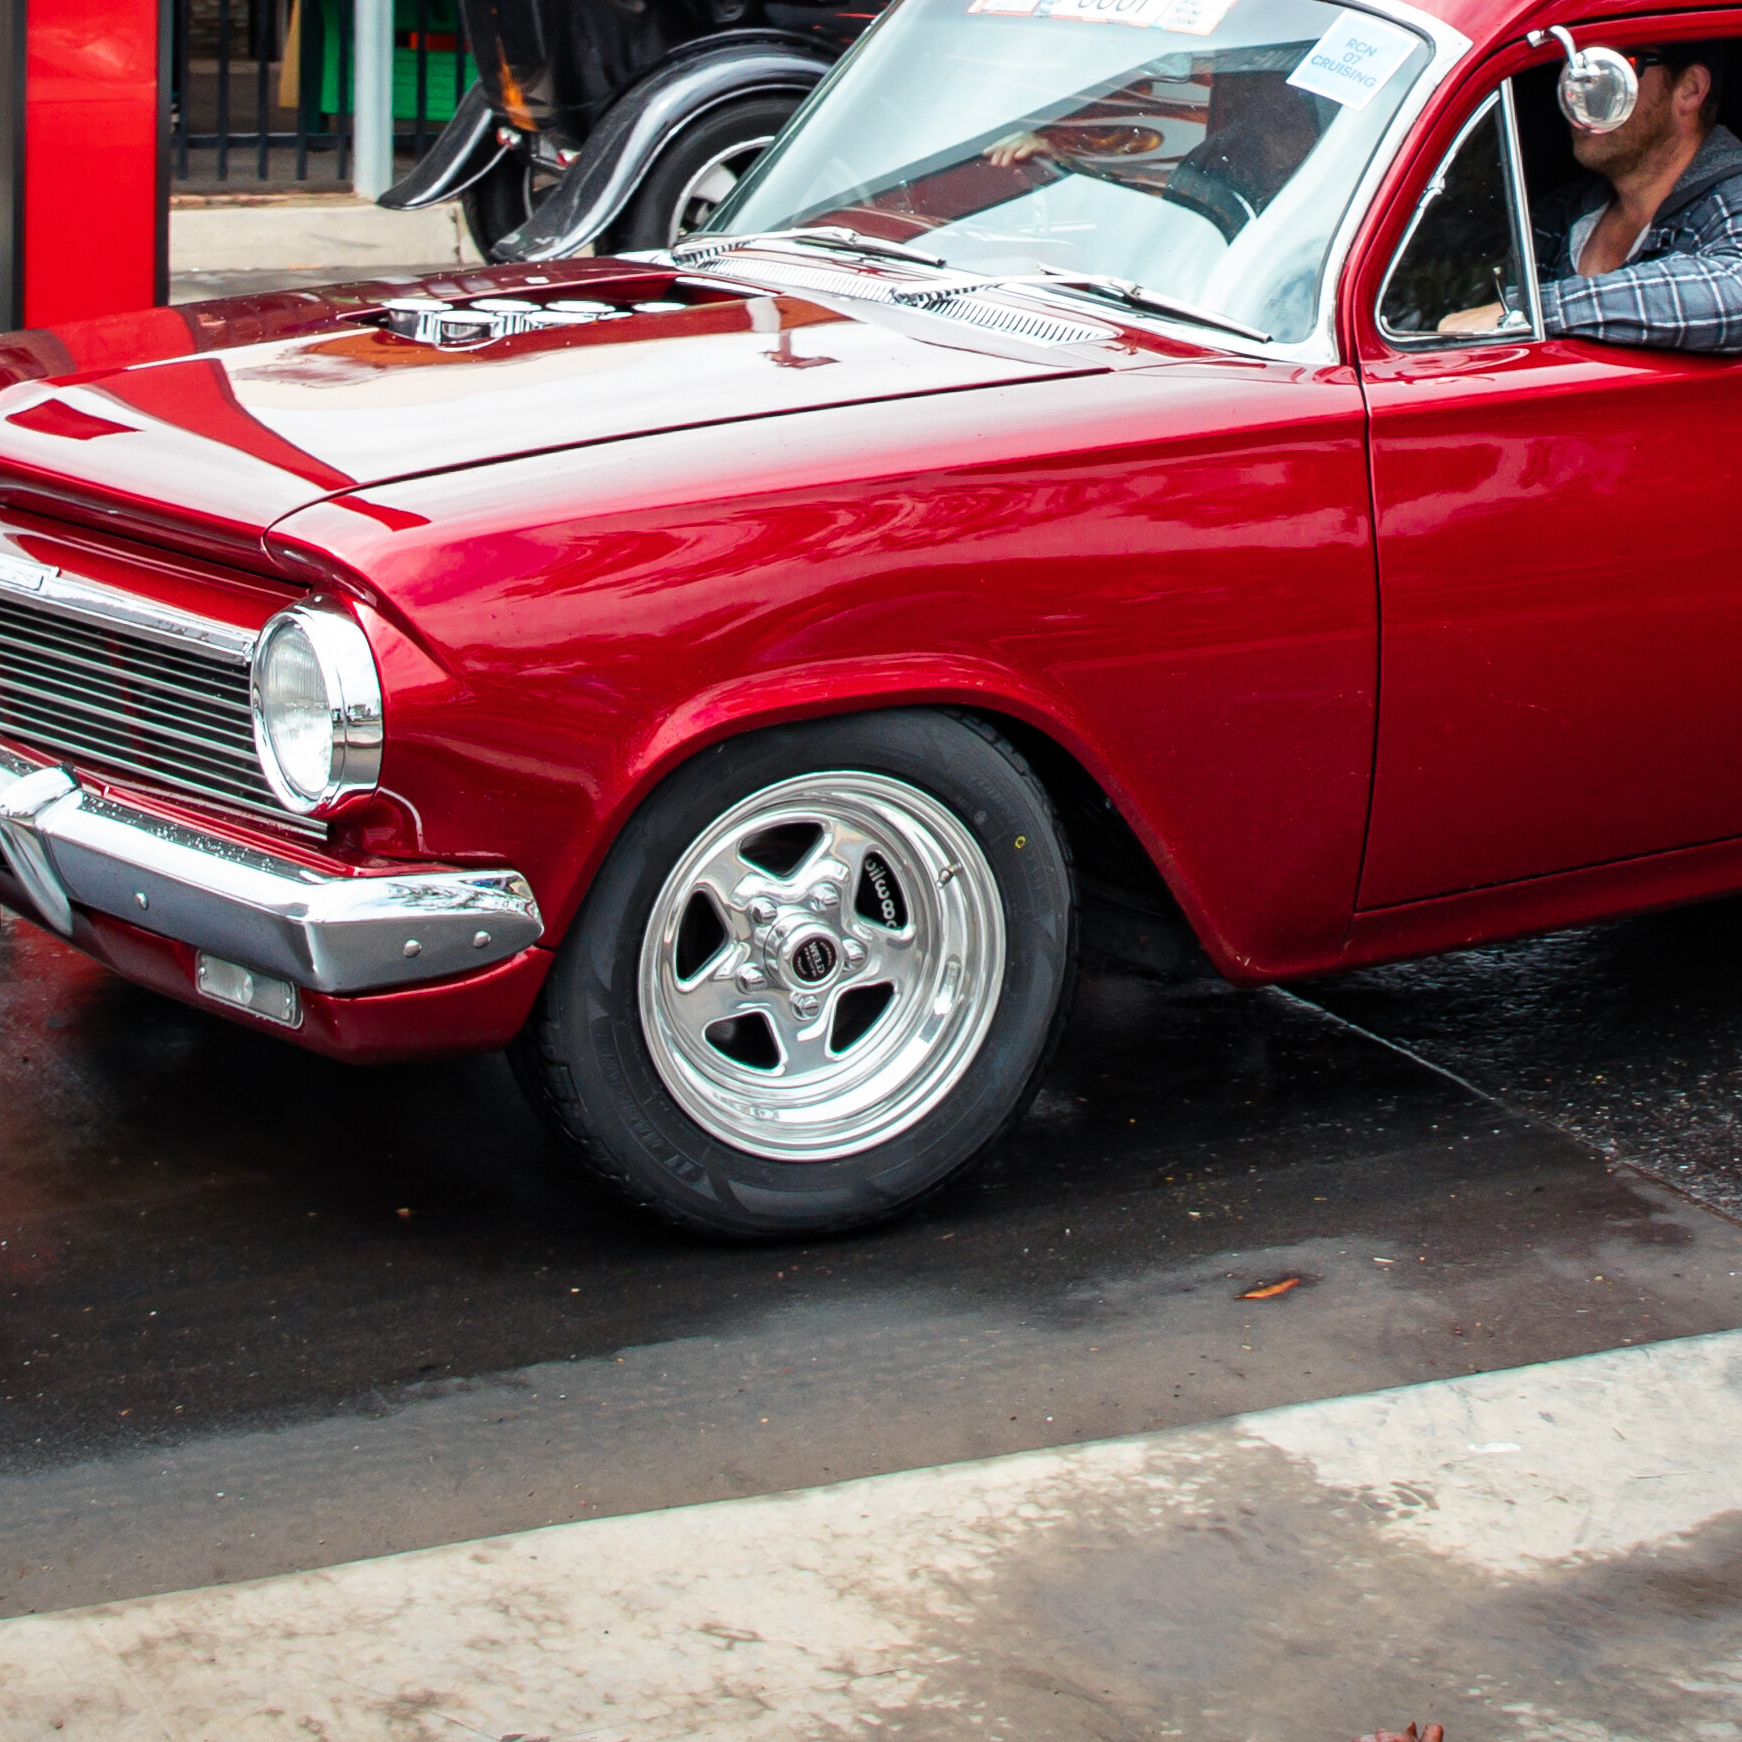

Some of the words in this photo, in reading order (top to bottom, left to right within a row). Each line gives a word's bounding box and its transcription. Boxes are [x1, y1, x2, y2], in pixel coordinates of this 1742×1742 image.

[1345, 38, 1378, 57] RCN
[1342, 52, 1362, 66] 07
[1310, 54, 1377, 88] CRUISING
